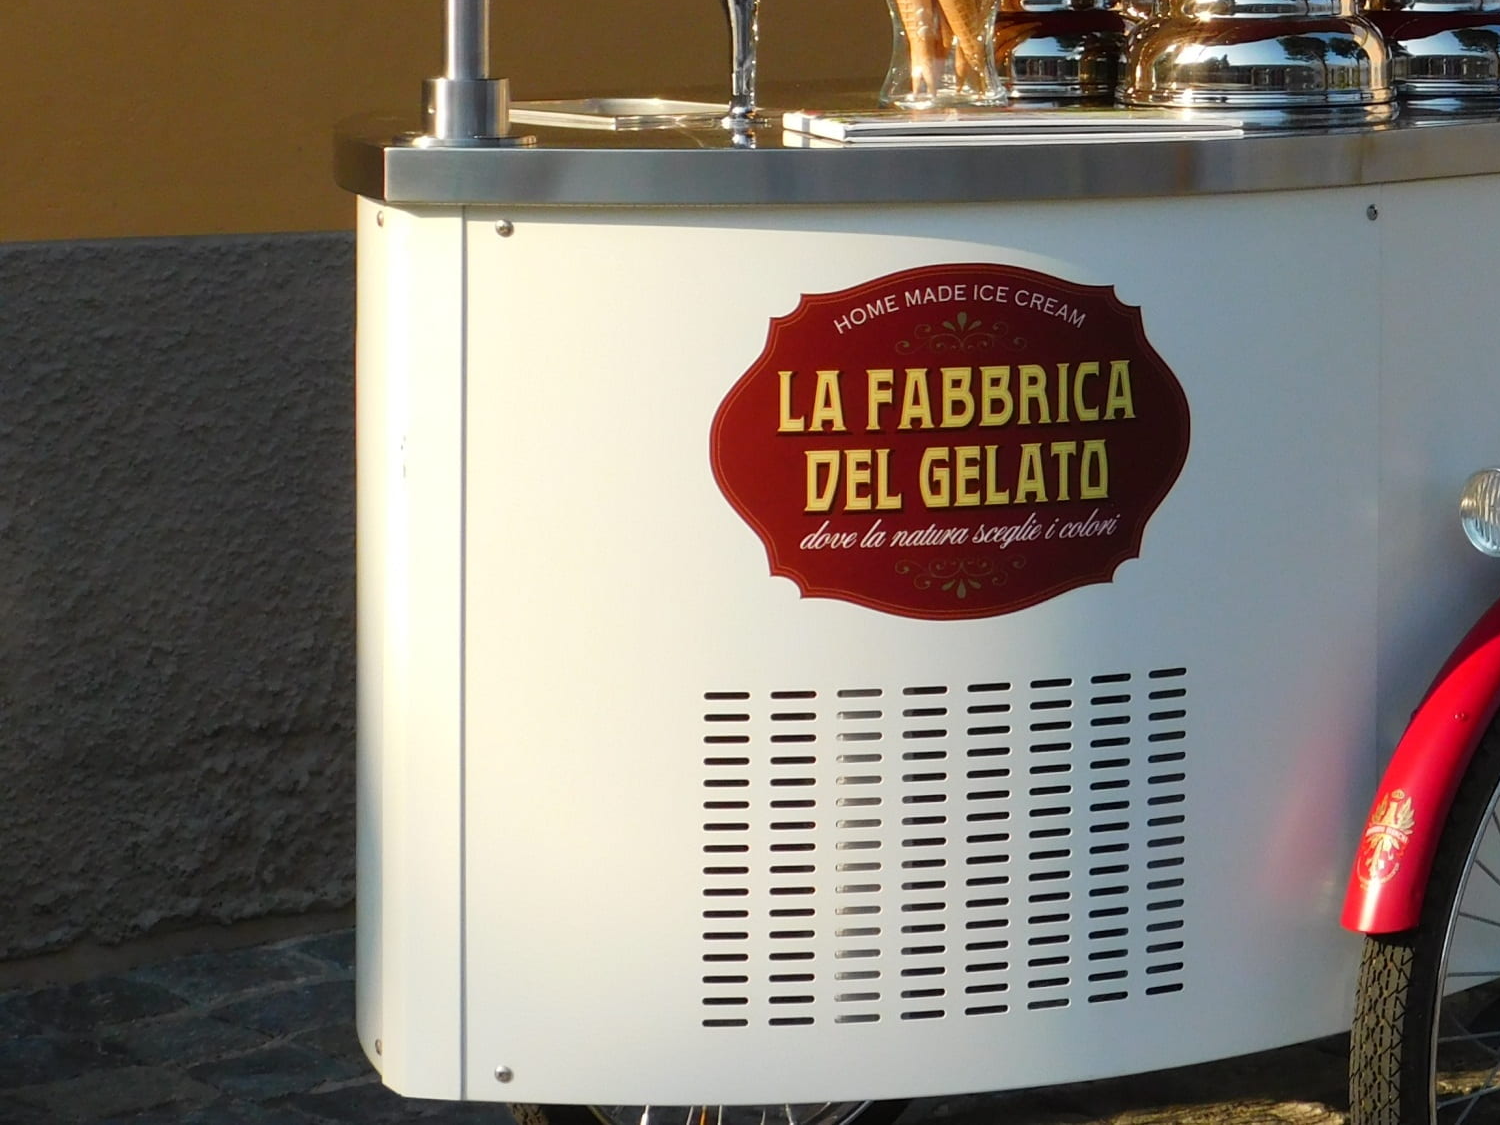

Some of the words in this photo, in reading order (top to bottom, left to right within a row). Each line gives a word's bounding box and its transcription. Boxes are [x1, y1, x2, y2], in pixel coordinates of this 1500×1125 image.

[833, 294, 899, 335] HOME
[904, 284, 967, 307] MADE
[973, 284, 1009, 303] ICE
[1014, 289, 1087, 329] CREAM
[776, 370, 847, 433] LA
[866, 360, 1137, 431] FABBRICA
[803, 448, 902, 512] DEL
[919, 438, 1109, 508] GELATO
[800, 520, 857, 550] dove
[860, 518, 887, 549] la
[889, 523, 969, 548] natura
[971, 512, 1043, 550] sceglie
[1045, 517, 1057, 540] i
[1058, 507, 1121, 539] colori
